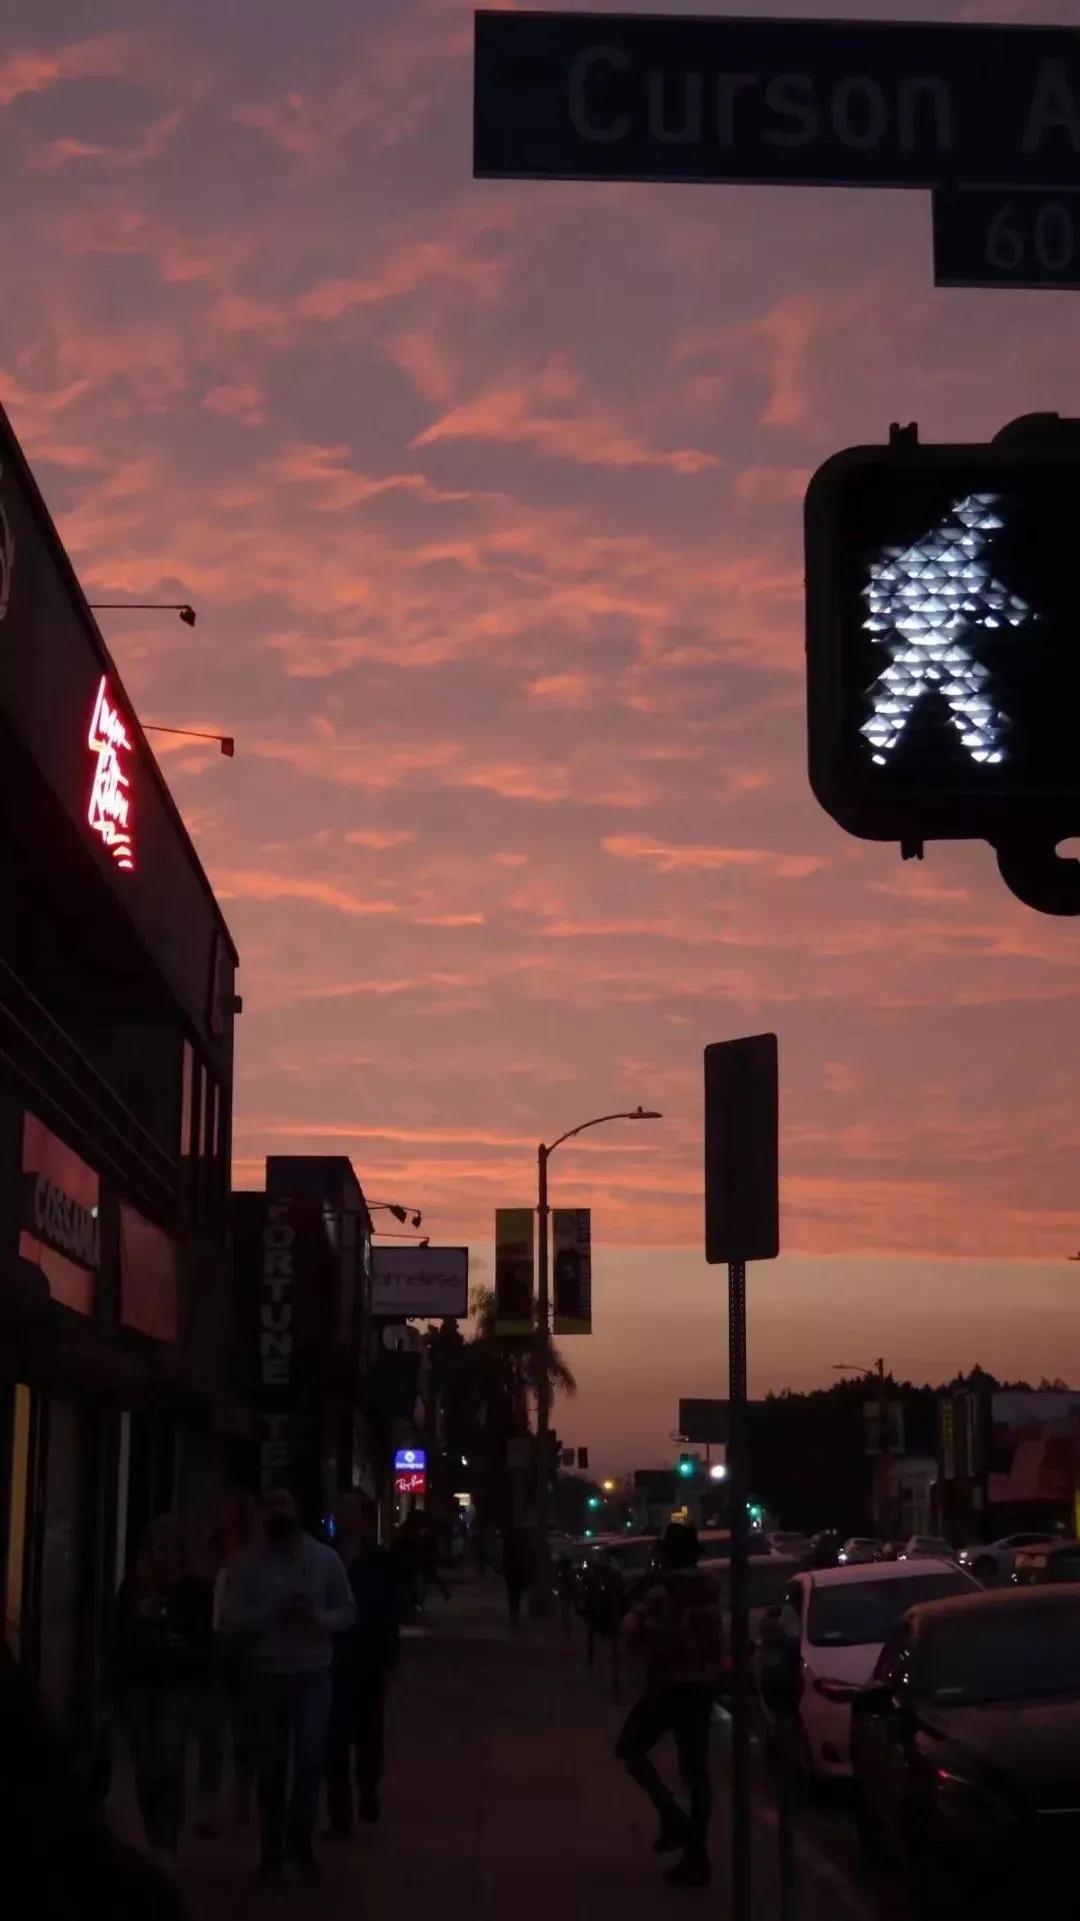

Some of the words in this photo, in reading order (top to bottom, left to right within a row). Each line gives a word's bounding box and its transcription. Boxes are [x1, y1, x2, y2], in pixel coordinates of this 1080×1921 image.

[566, 44, 953, 153] Curson
[984, 202, 1073, 271] 60
[260, 1198, 296, 1385] FORTUNE
